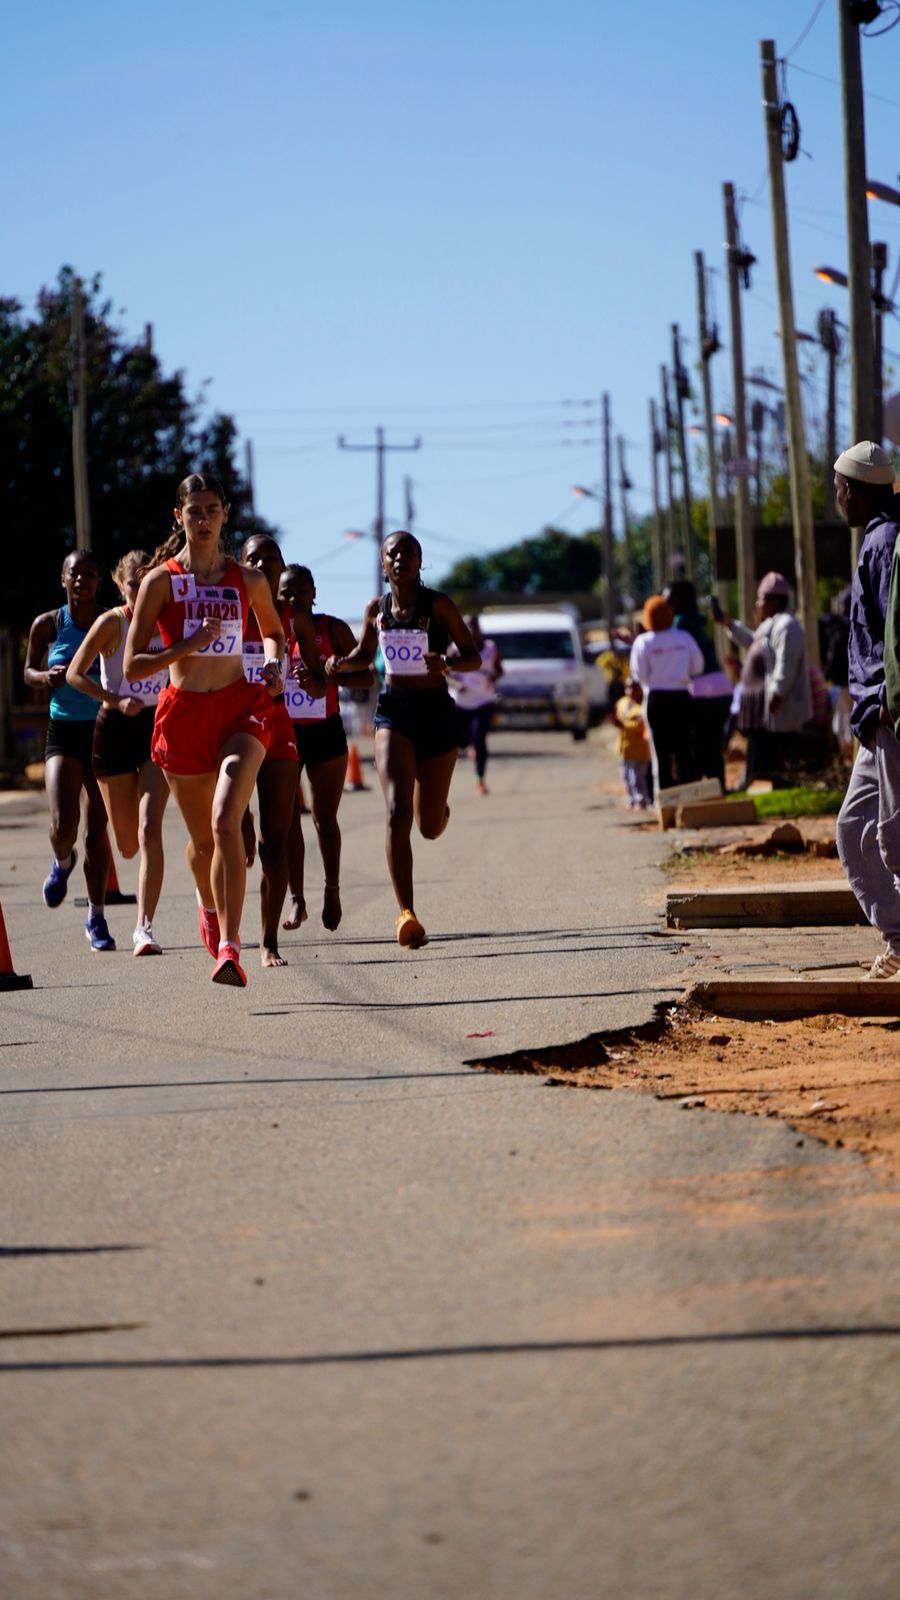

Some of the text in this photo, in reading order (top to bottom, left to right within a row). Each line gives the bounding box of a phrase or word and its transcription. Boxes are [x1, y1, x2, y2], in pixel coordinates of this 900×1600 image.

[177, 578, 189, 596] J
[385, 645, 423, 661] 002
[129, 680, 161, 695] 056
[285, 692, 316, 707] 109
